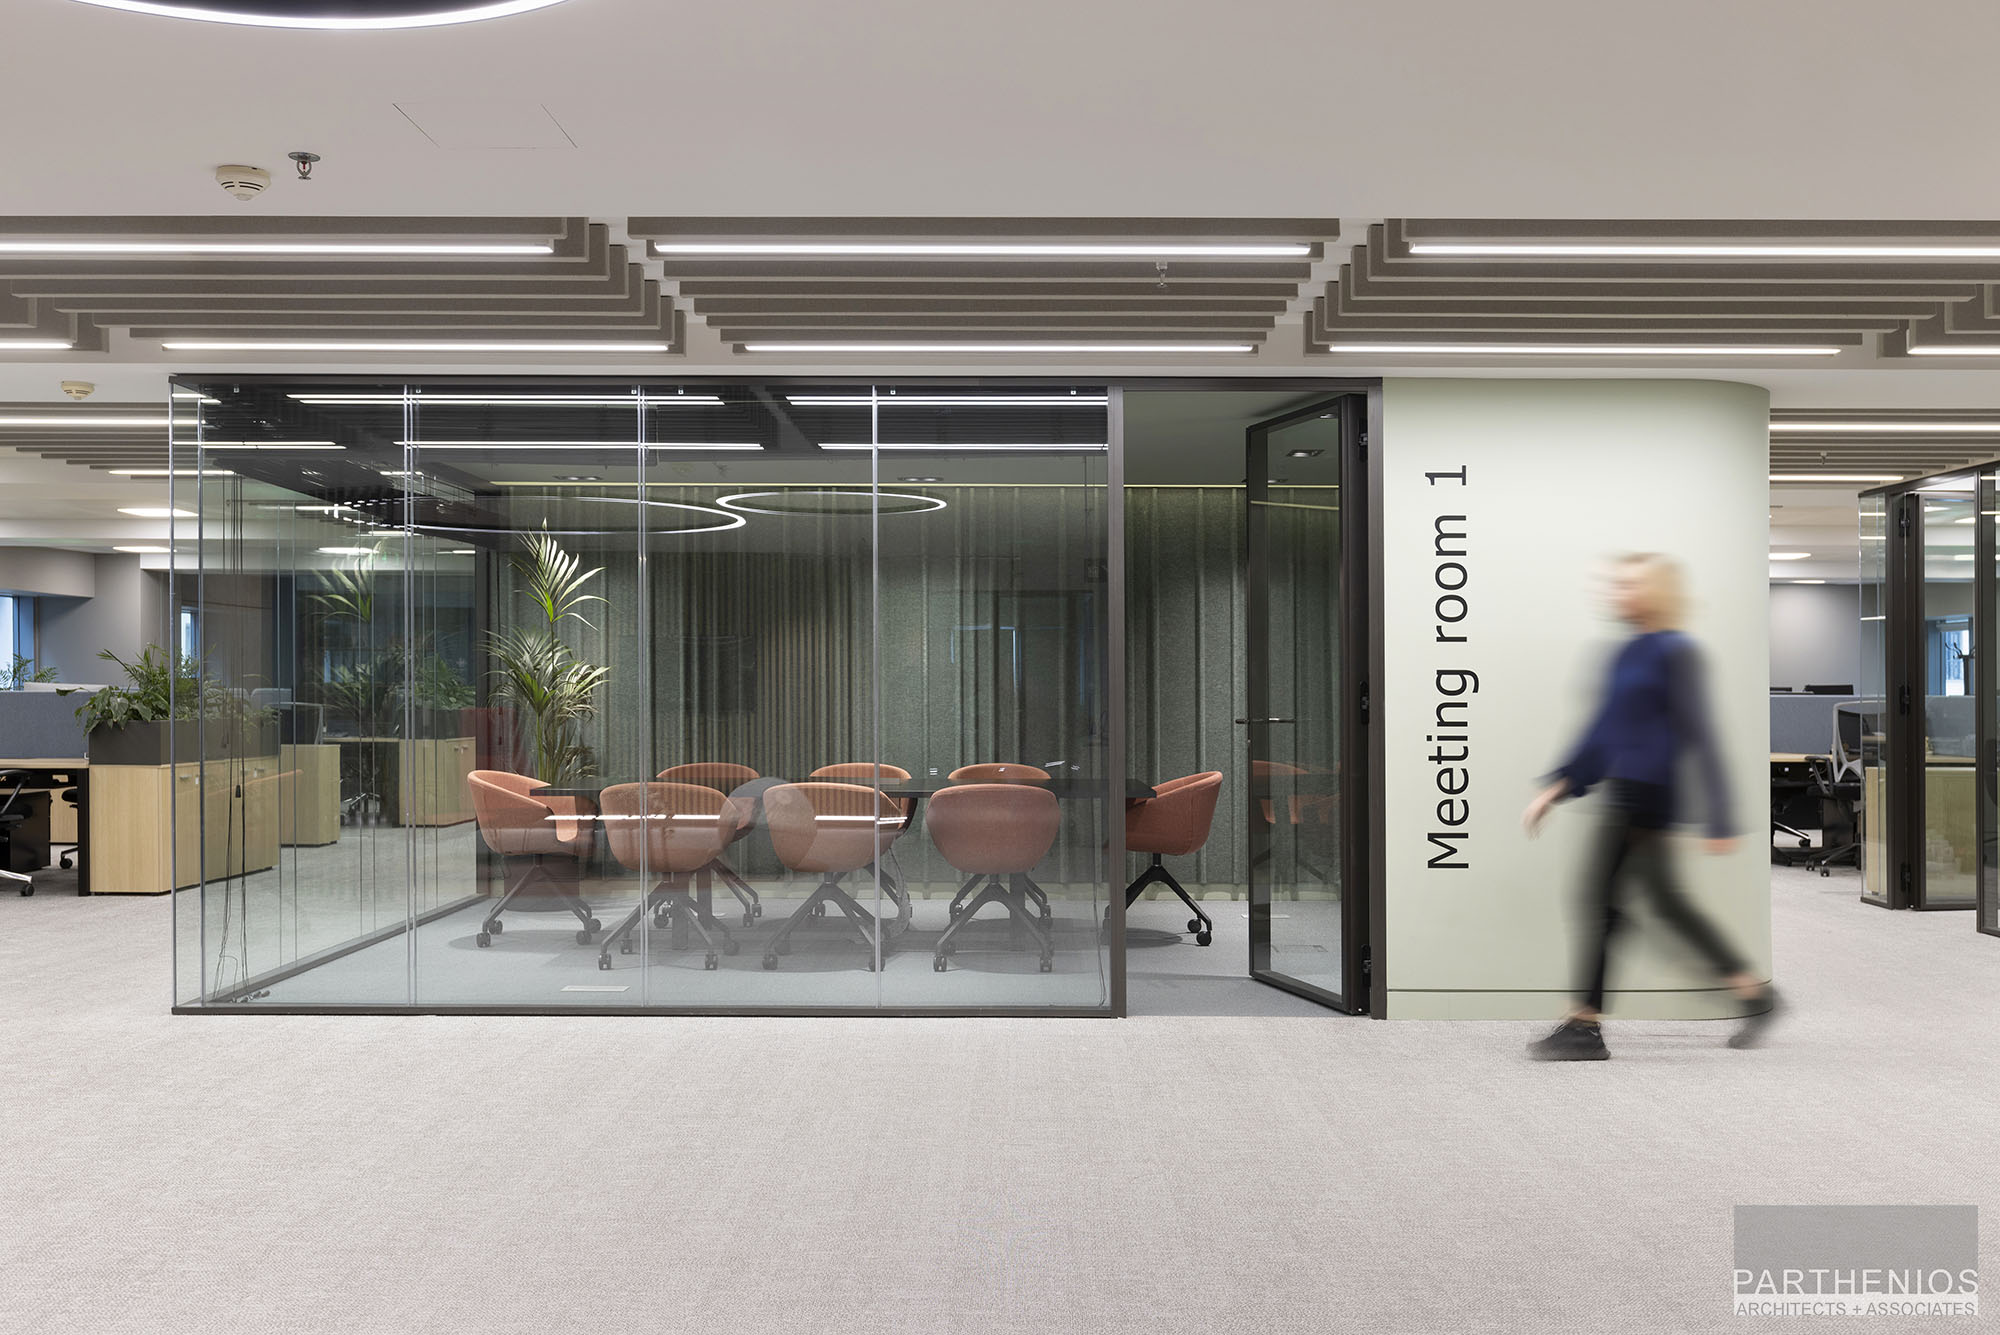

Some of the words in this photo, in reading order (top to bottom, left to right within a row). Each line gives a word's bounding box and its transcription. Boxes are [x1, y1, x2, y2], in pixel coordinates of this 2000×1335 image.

[1425, 465, 1467, 486] 1
[1434, 514, 1467, 643] room
[1426, 668, 1479, 869] Meeting
